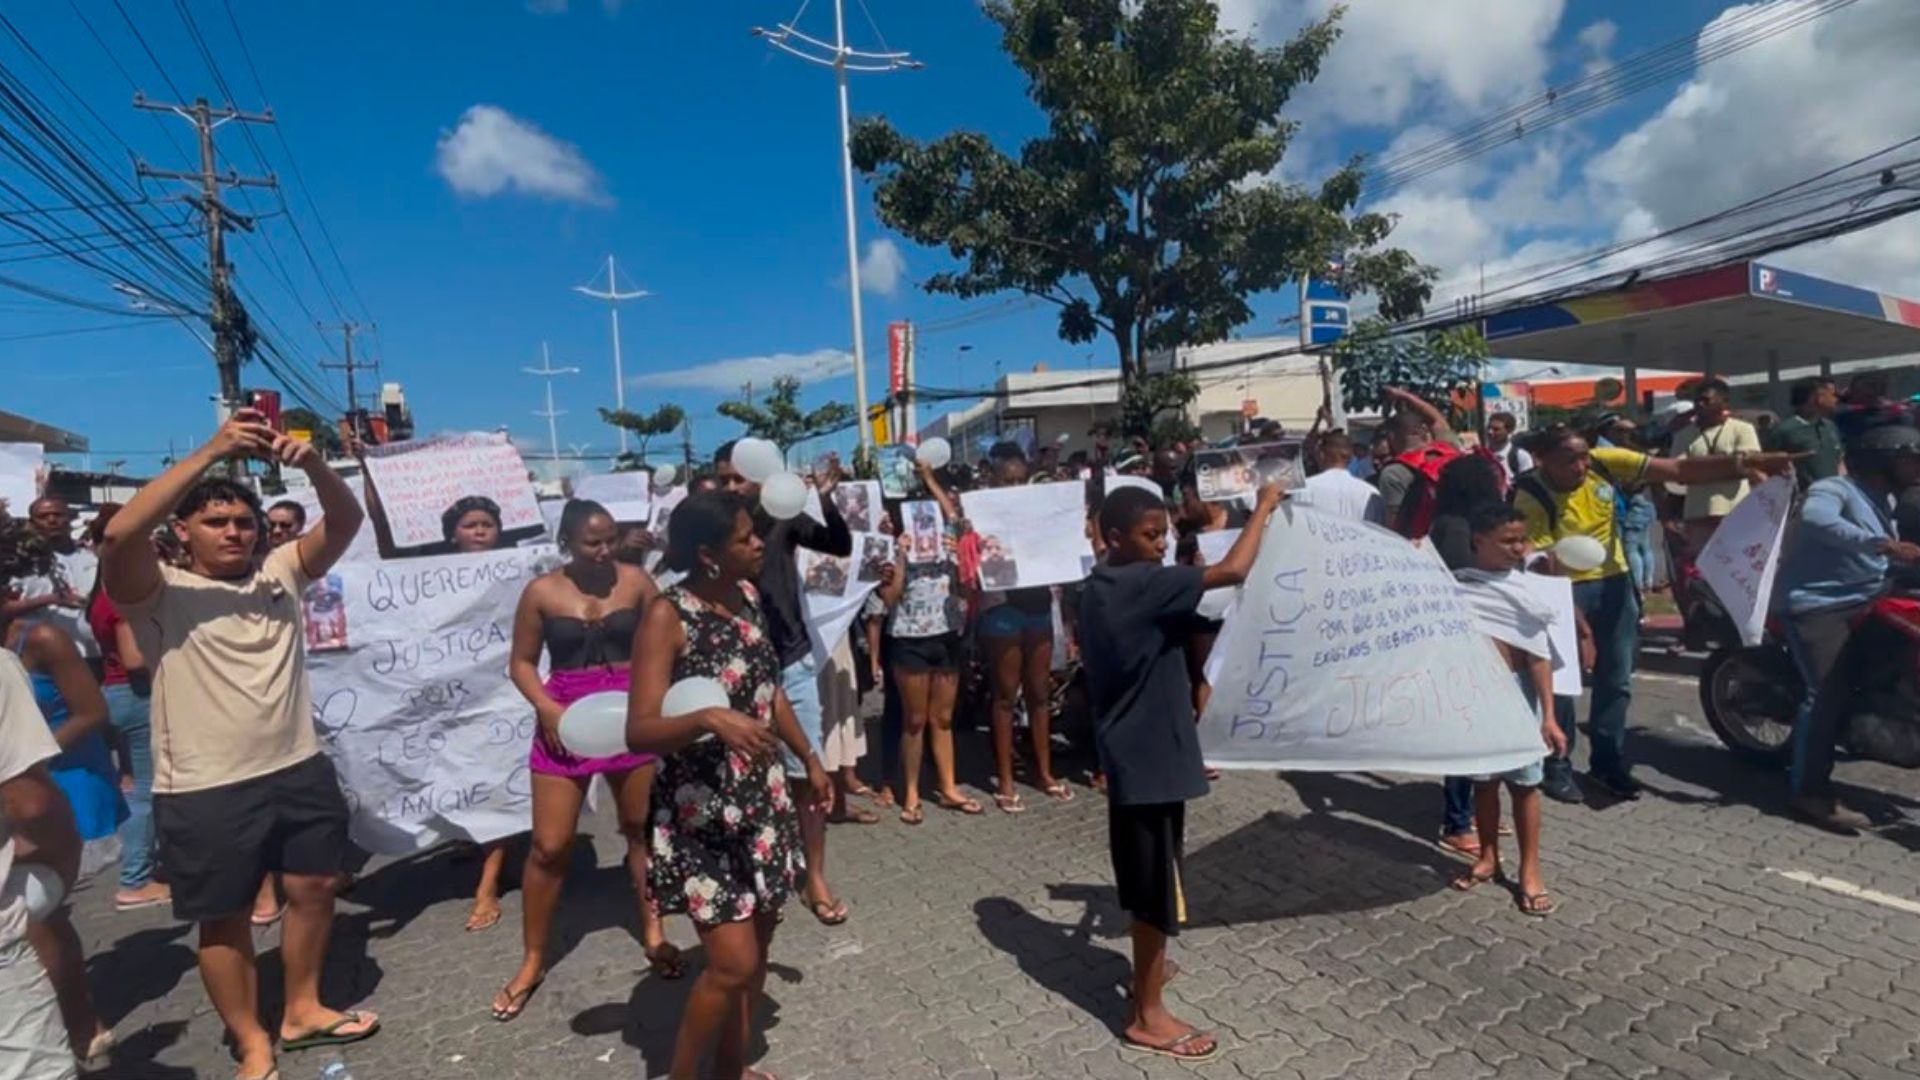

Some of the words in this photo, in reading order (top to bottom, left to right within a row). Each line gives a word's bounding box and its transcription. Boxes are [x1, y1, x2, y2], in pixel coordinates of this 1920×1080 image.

[367, 558, 521, 612] QUEREMOS
[373, 622, 506, 675] JUSTIÇA
[401, 679, 470, 707] POR
